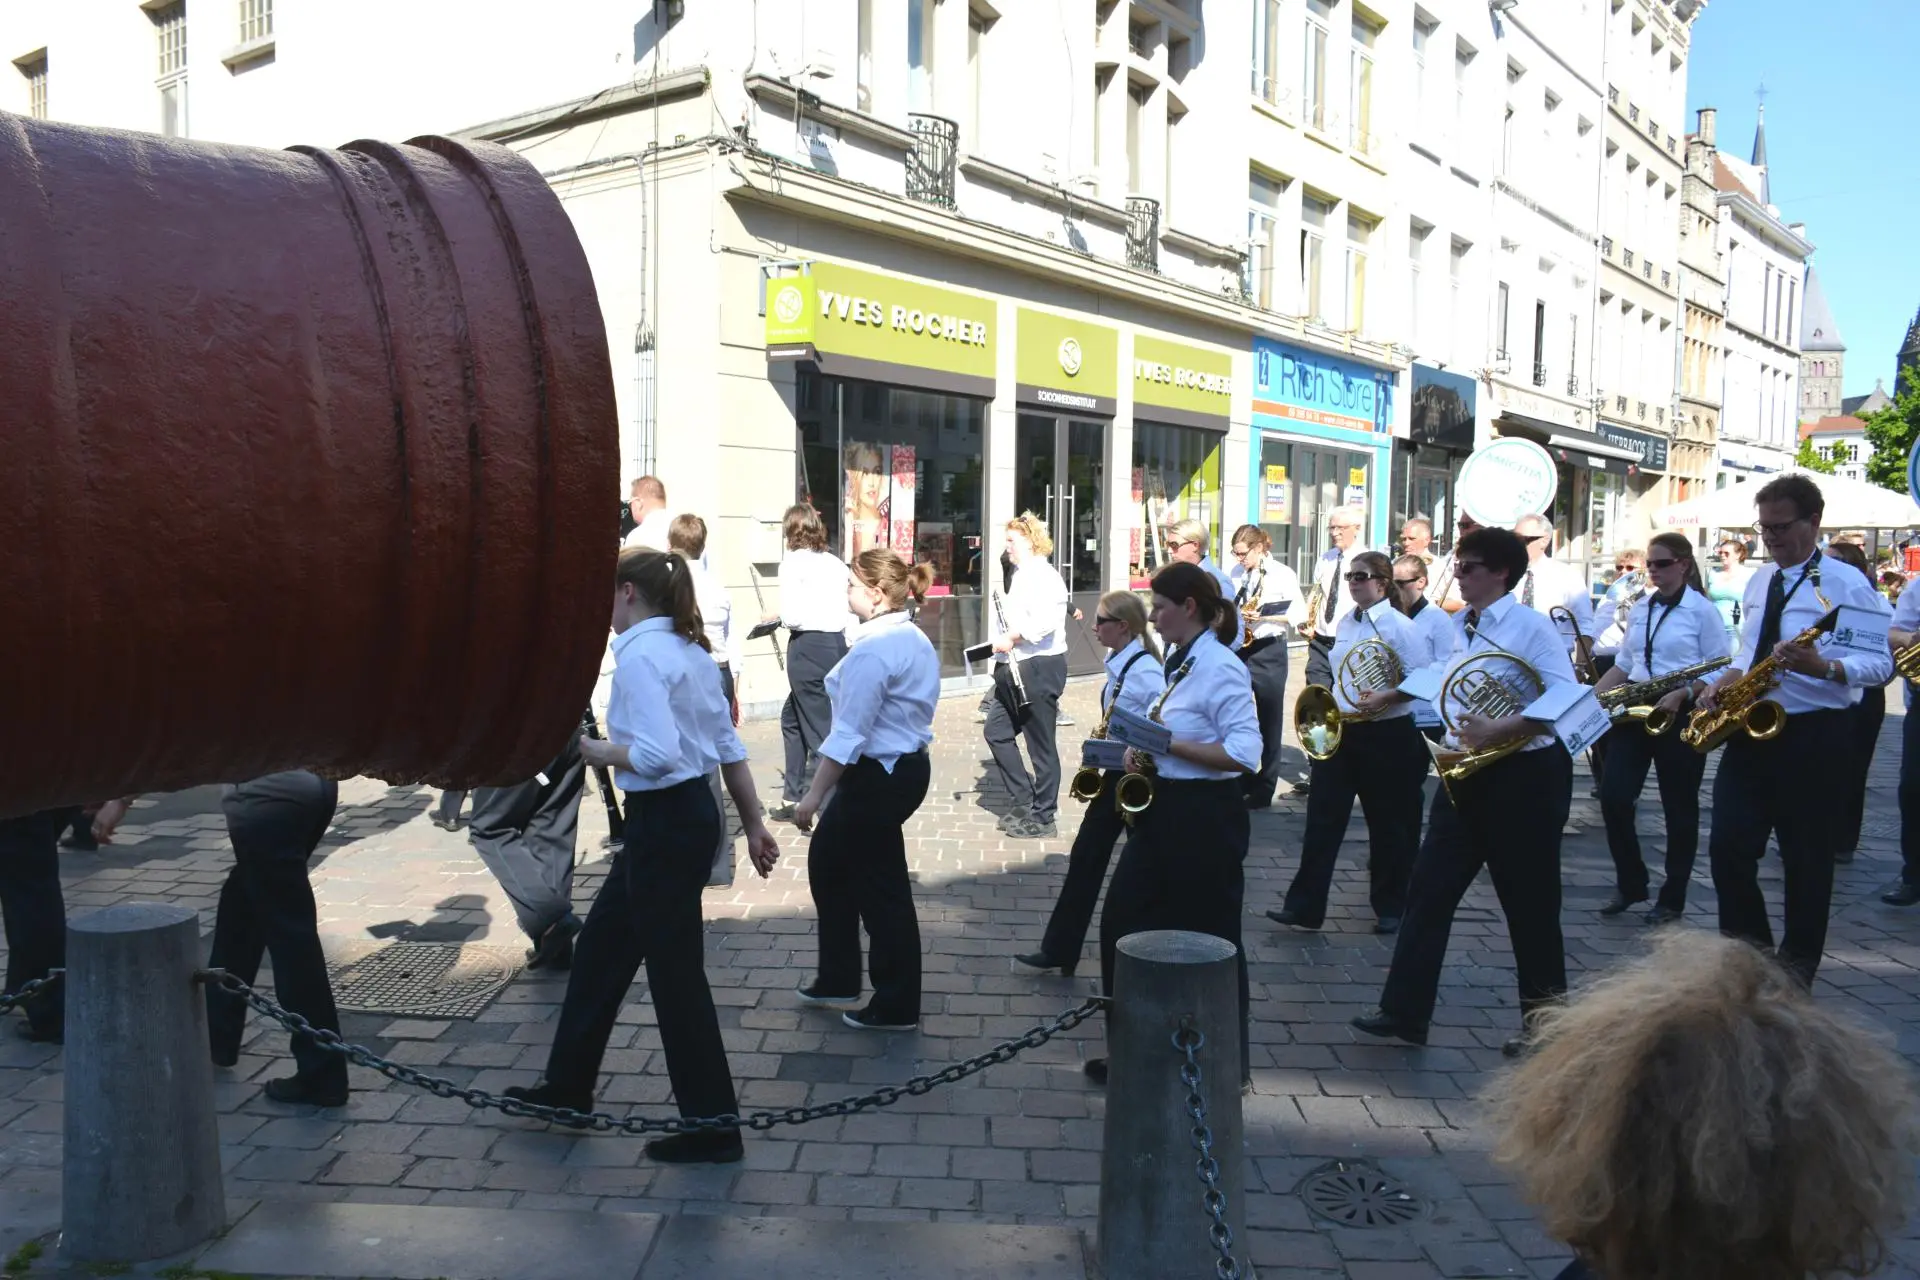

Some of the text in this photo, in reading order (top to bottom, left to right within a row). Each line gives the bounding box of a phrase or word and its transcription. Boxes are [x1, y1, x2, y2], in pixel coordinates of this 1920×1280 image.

[817, 289, 987, 347] YVES ROCHER
[1134, 358, 1171, 385] YVES
[1281, 352, 1372, 413] Rich Store
